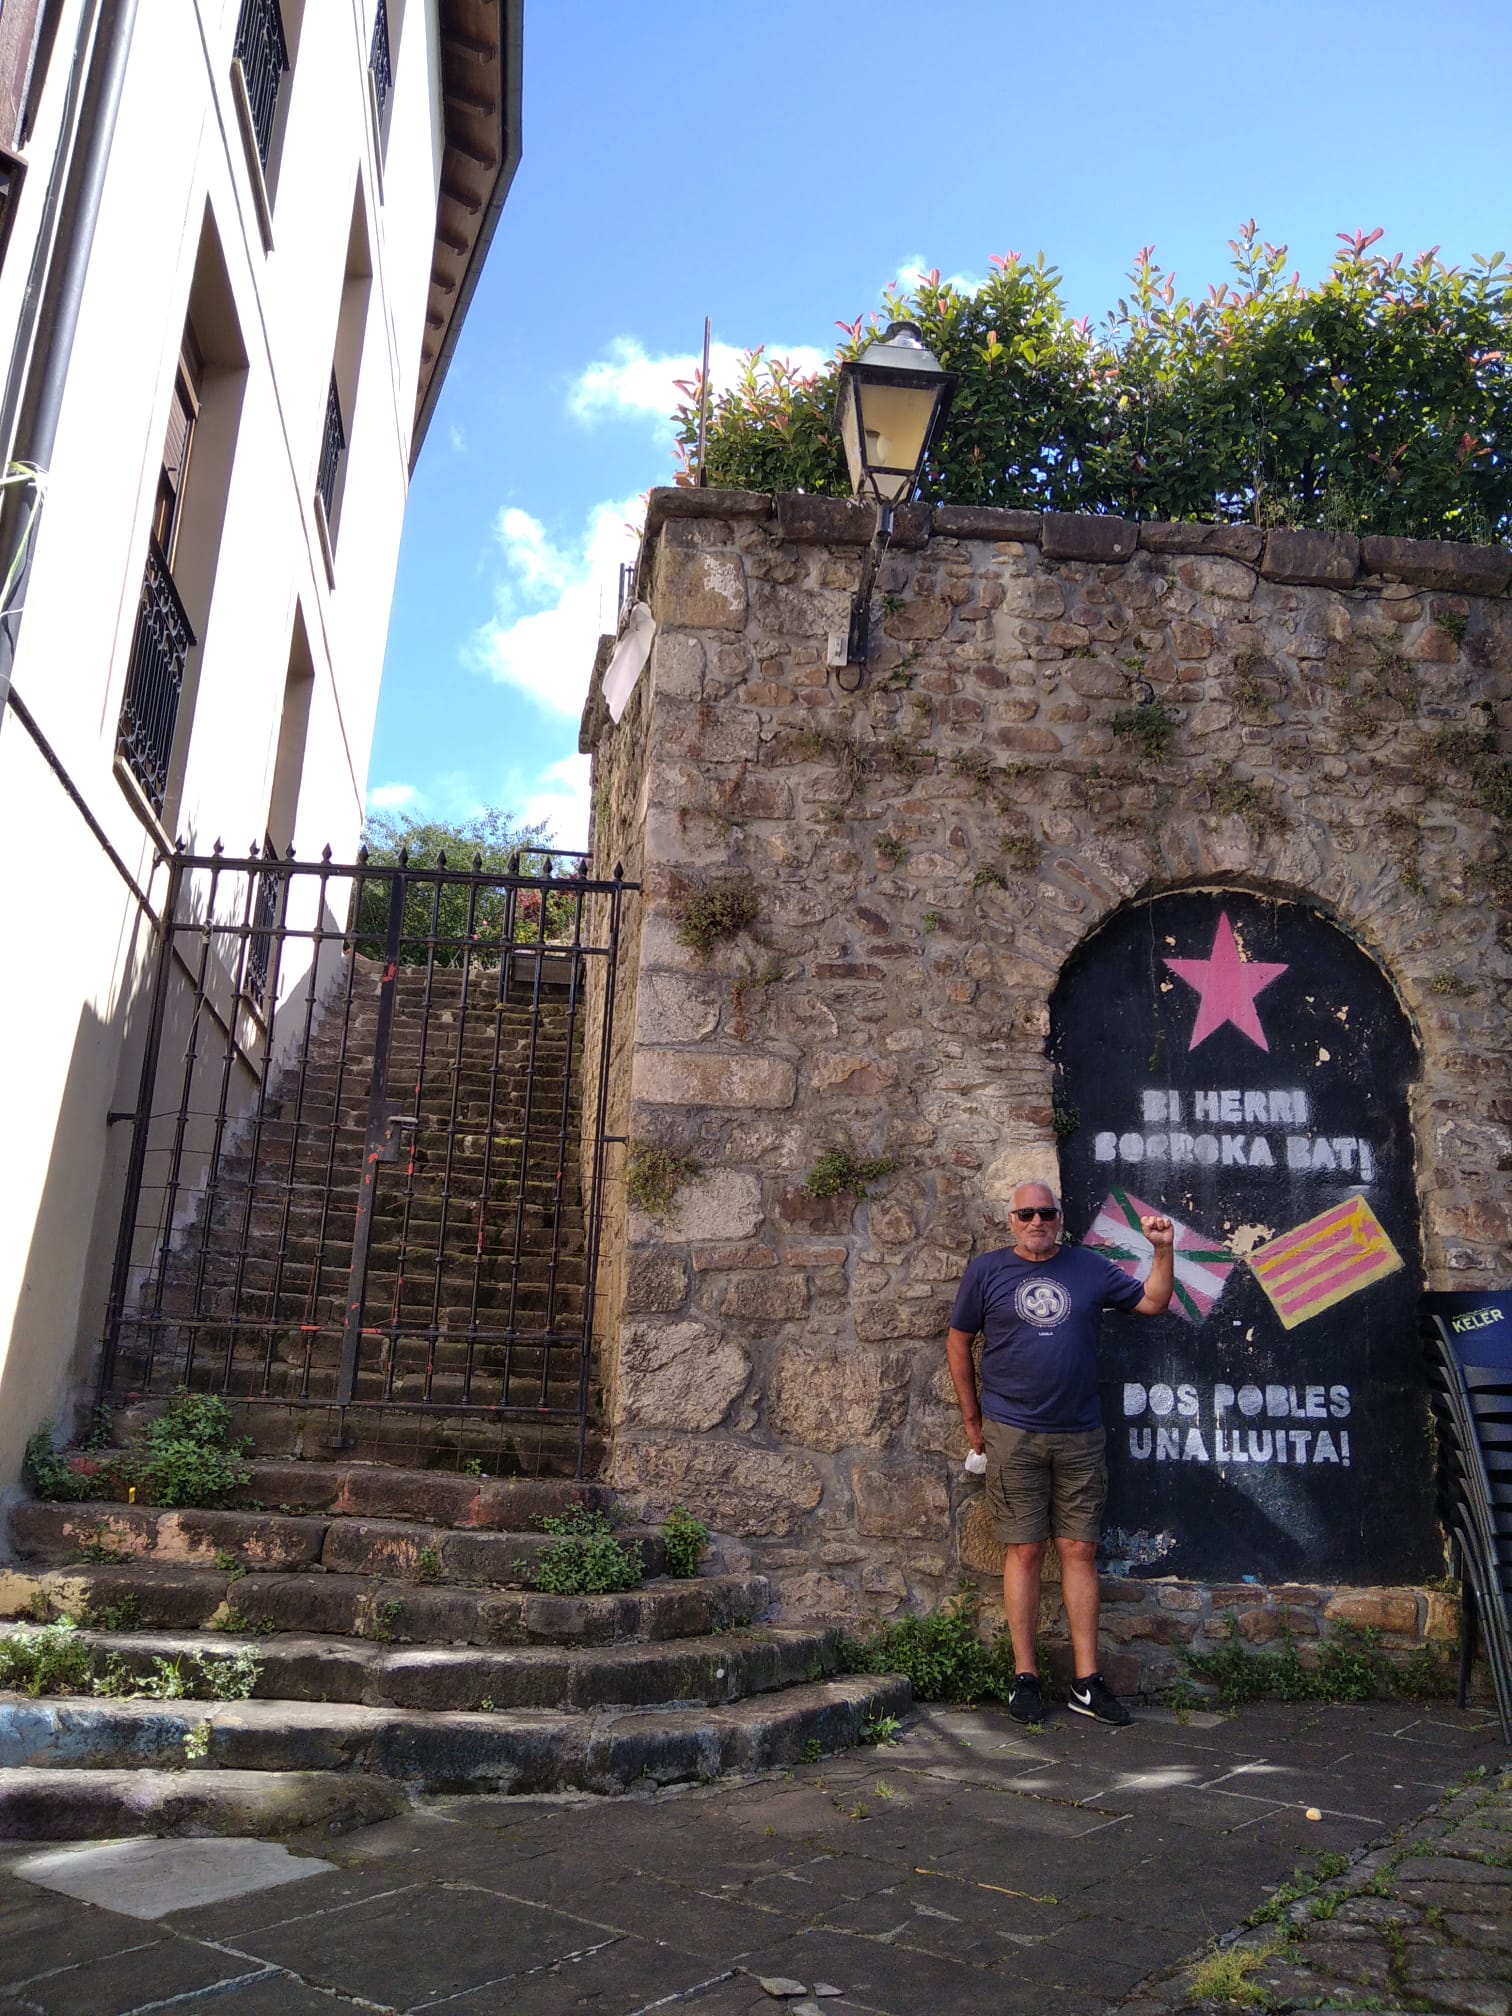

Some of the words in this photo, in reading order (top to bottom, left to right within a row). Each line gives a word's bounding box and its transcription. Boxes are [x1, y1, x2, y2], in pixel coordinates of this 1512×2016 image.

[1142, 1089, 1180, 1121] BI
[1195, 1090, 1307, 1123] HERRI
[1094, 1131, 1275, 1166] BORROKA
[1451, 1308, 1505, 1333] KELER
[1123, 1383, 1199, 1416] DOS
[1214, 1384, 1351, 1418] POBLES
[1129, 1427, 1209, 1461] UNA
[1215, 1429, 1351, 1468] LLUITA!
